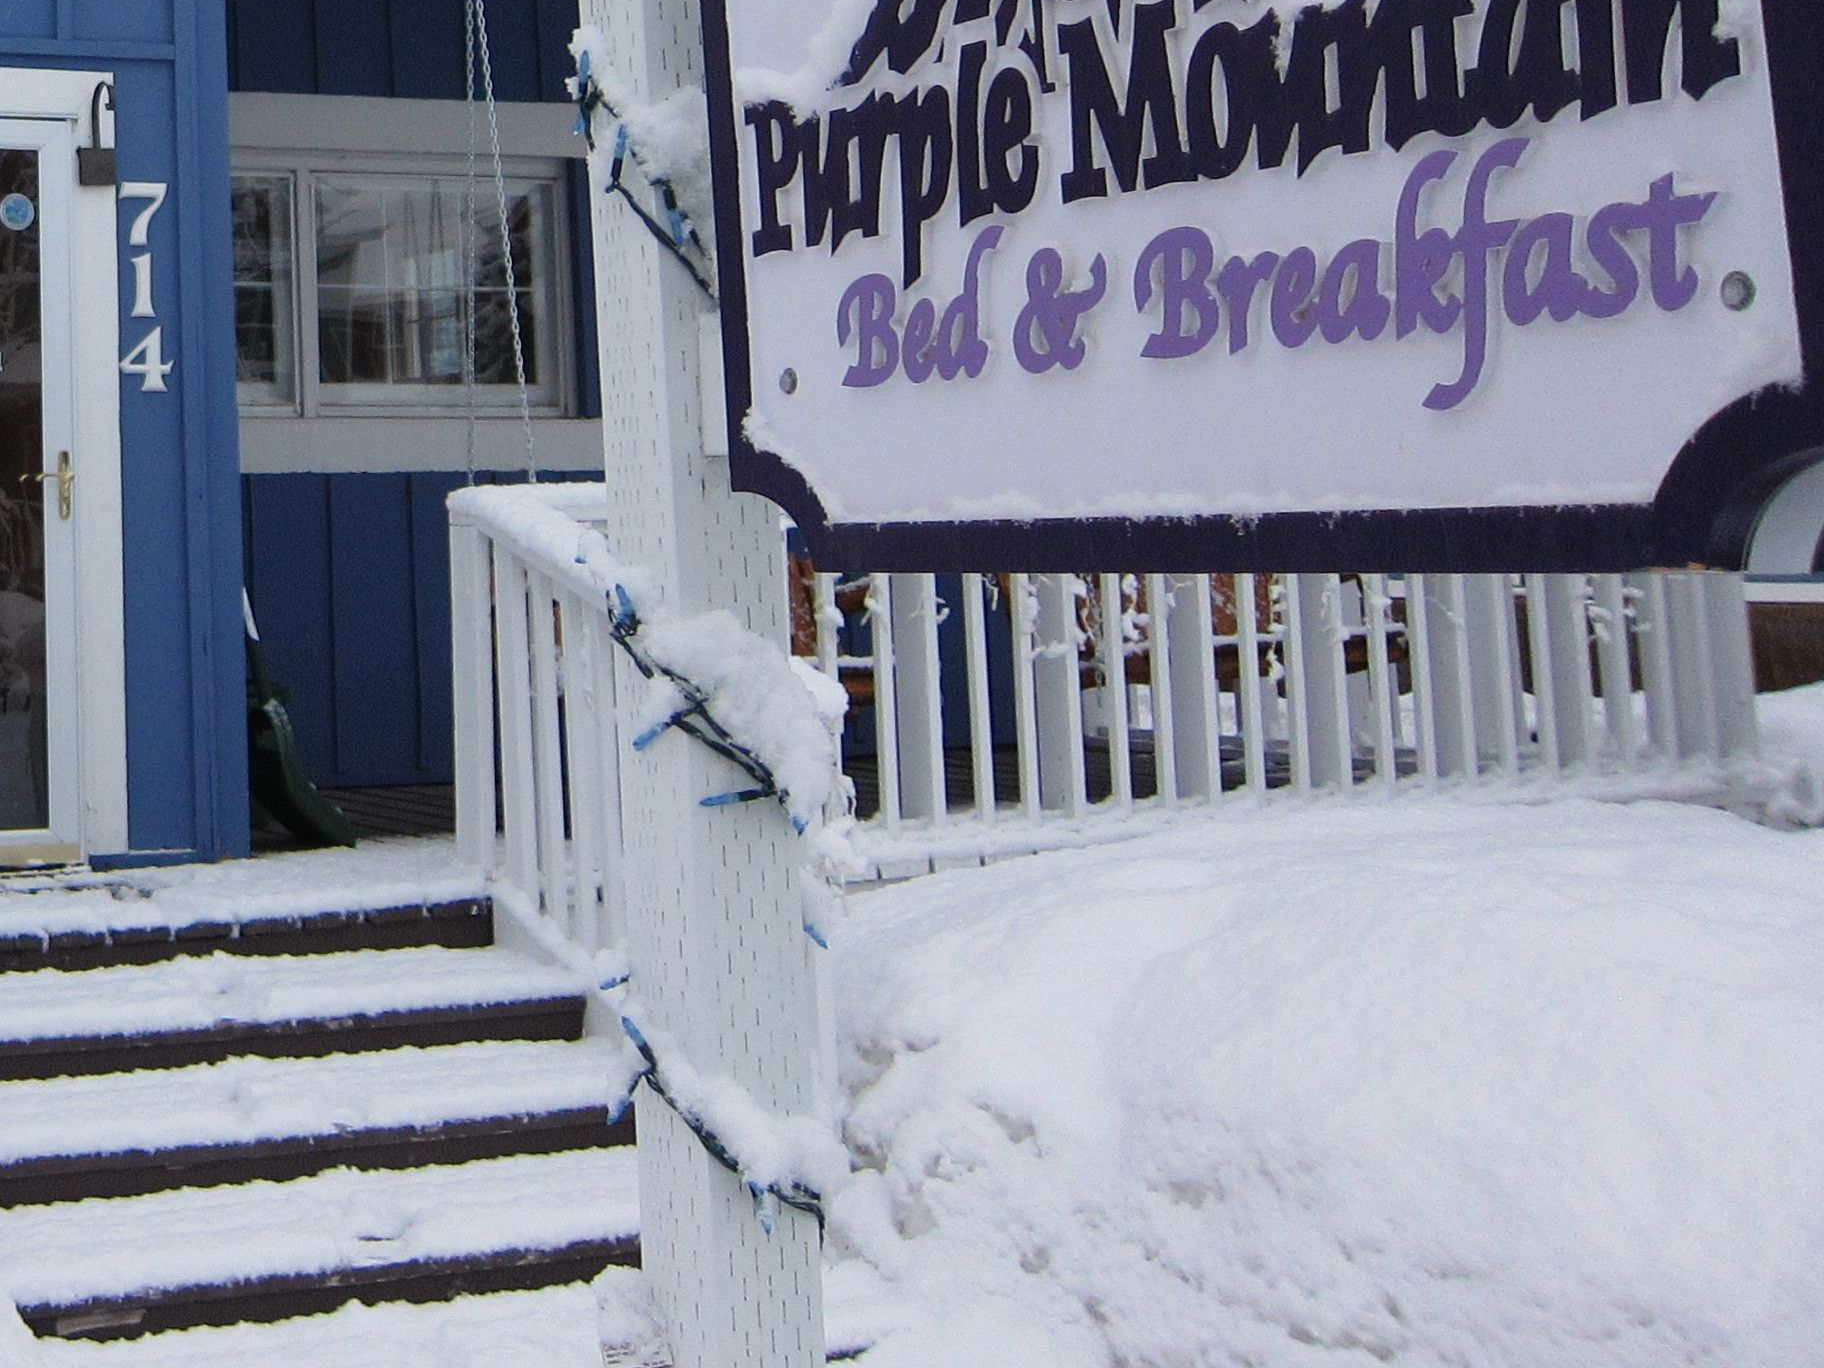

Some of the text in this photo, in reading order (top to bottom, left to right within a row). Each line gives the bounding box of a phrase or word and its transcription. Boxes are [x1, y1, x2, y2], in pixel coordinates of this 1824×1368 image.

[119, 182, 174, 392] 714
[745, 37, 1042, 289] Purple
[838, 137, 1718, 410] Bed & Breakfast
